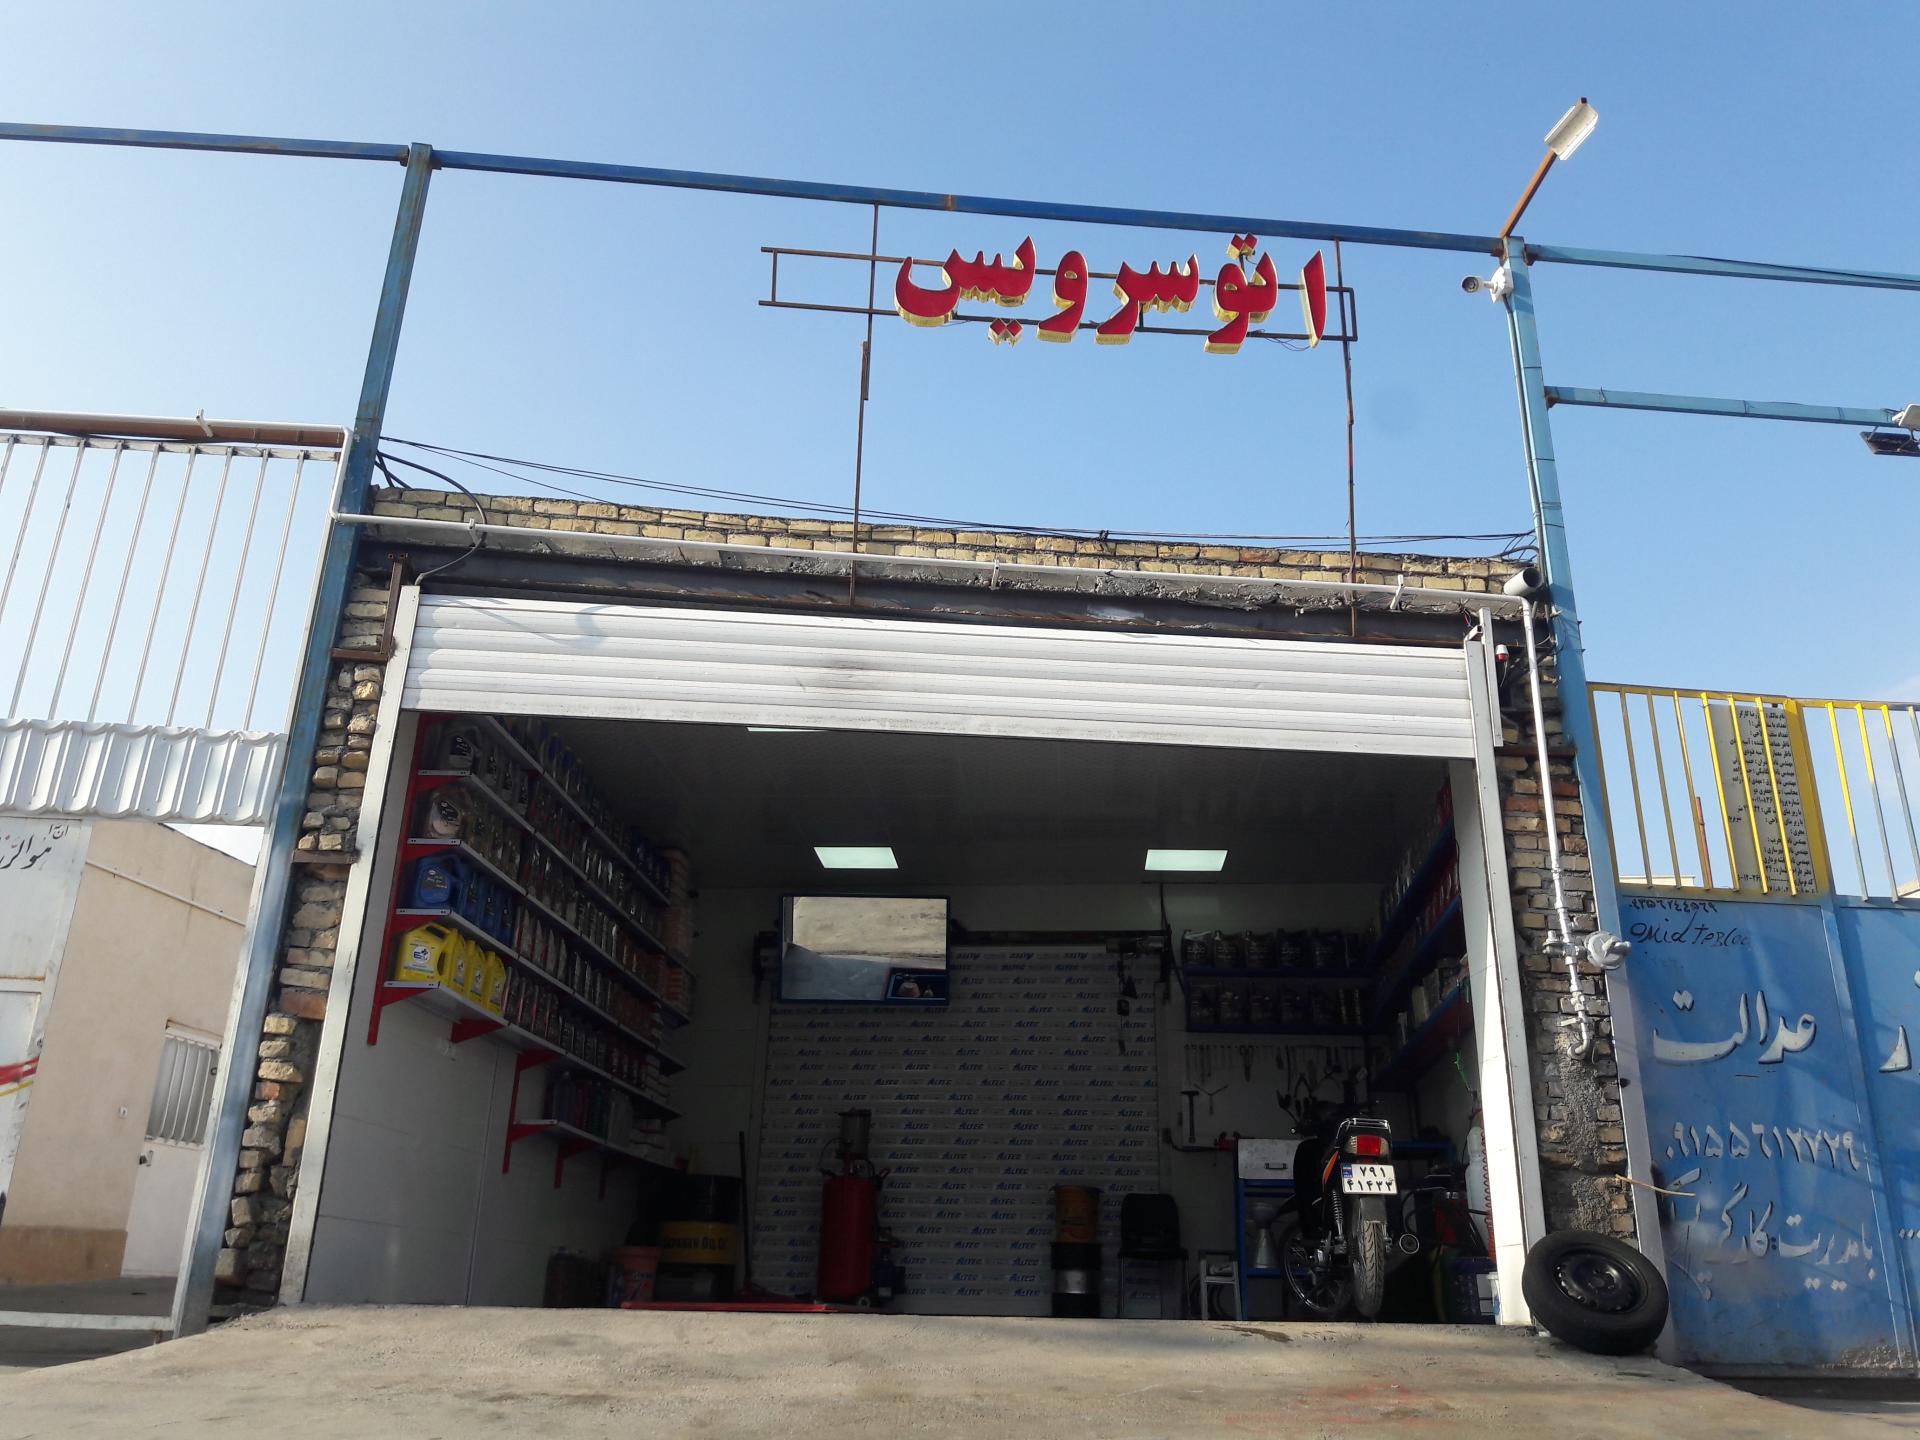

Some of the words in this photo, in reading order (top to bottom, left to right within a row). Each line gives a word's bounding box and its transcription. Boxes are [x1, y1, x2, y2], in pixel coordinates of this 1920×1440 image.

[1000, 963, 1025, 971] ALTEC
[1054, 963, 1078, 971] ALTEC
[1012, 976, 1036, 984] ALTEC
[1064, 976, 1089, 984] ALTEC
[970, 991, 994, 1000] ALTEC
[1022, 991, 1046, 999] ALTEC
[1075, 991, 1100, 999] ALTEC
[975, 1005, 1000, 1014] ALTEC
[1028, 1005, 1052, 1013] ALTEC
[1081, 1005, 1105, 1014] ALTEC
[805, 1020, 830, 1028] ALTEC
[857, 1020, 882, 1028] ALTEC
[909, 1020, 934, 1028] ALTEC
[961, 1020, 986, 1028] ALTEC
[1014, 1020, 1038, 1028] ALTEC
[1067, 1020, 1092, 1028] ALTEC
[1653, 990, 1817, 1065] عدالت
[816, 1035, 841, 1043] ALTEC
[868, 1034, 893, 1042] ALTEC
[920, 1034, 945, 1042] ALTEC
[974, 1034, 998, 1042] ALTEC
[1027, 1034, 1051, 1042] ALTEC
[1080, 1035, 1105, 1043] ALTEC
[796, 1048, 821, 1056] ALTEC
[849, 1048, 873, 1056] ALTEC
[902, 1048, 926, 1056] ALTEC
[955, 1048, 980, 1056] ALTEC
[1009, 1048, 1034, 1056] ALTEC
[1063, 1048, 1088, 1056] ALTEC
[799, 1062, 823, 1070] ALTEC
[851, 1062, 876, 1070] ALTEC
[904, 1062, 929, 1070] ALTEC
[958, 1063, 982, 1071] ALTEC
[1012, 1063, 1037, 1071] ALTEC
[1067, 1063, 1091, 1072] ALTEC
[1122, 1064, 1147, 1072] ALTEC
[768, 1078, 793, 1086] ALTEC
[821, 1078, 845, 1086] ALTEC
[874, 1077, 898, 1086] ALTEC
[926, 1077, 951, 1086] ALTEC
[980, 1078, 1004, 1086] ALTEC
[1034, 1078, 1058, 1086] ALTEC
[1088, 1079, 1112, 1087] ALTEC
[789, 1093, 813, 1101] ALTEC
[842, 1093, 866, 1101] ALTEC
[894, 1092, 919, 1100] ALTEC
[948, 1093, 972, 1101] ALTEC
[1002, 1093, 1026, 1101] ALTEC
[1056, 1093, 1080, 1102] ALTEC
[1111, 1094, 1135, 1102] ALTEC
[794, 1107, 818, 1115] ALTEC
[900, 1107, 924, 1115] ALTEC
[953, 1107, 978, 1115] ALTEC
[1008, 1107, 1032, 1116] ALTEC
[1062, 1108, 1086, 1116] ALTEC
[1117, 1109, 1142, 1117] ALTEC
[797, 1121, 821, 1129] ALTEC
[904, 1121, 928, 1130] ALTEC
[1013, 1122, 1038, 1130] ALTEC
[1068, 1123, 1092, 1131] ALTEC
[1124, 1124, 1148, 1132] ALTEC
[793, 1136, 818, 1144] ALTEC
[900, 1137, 924, 1145] ALTEC
[954, 1137, 978, 1145] ALTEC
[1008, 1138, 1032, 1146] ALTEC
[1063, 1138, 1087, 1146] ALTEC
[1118, 1139, 1142, 1147] ALTEC
[781, 1151, 806, 1159] ALTEC
[888, 1151, 912, 1159] ALTEC
[942, 1152, 966, 1160] ALTEC
[996, 1152, 1020, 1160] ALTEC
[1051, 1153, 1076, 1161] ALTEC
[1106, 1154, 1131, 1162] ALTEC
[786, 1164, 811, 1172] ALTEC
[894, 1165, 918, 1173] ALTEC
[948, 1166, 973, 1174] ALTEC
[1003, 1167, 1028, 1175] ALTEC
[1058, 1167, 1083, 1176] ALTEC
[1114, 1168, 1139, 1176] ALTEC
[1359, 1166, 1386, 1178] ۷۹۱
[777, 1179, 802, 1187] ALTEC
[941, 1182, 965, 1190] ALTEC
[996, 1182, 1020, 1190] ALTEC
[1108, 1183, 1132, 1191] ALTEC
[770, 1195, 794, 1203] ALTEC
[934, 1196, 958, 1204] ALTEC
[990, 1197, 1014, 1205] ALTEC
[772, 1208, 797, 1216] ALTEC
[935, 1210, 960, 1218] ALTEC
[990, 1211, 1015, 1220] ALTEC
[916, 1225, 940, 1234] ALTEC
[971, 1226, 996, 1234] ALTEC
[954, 1240, 978, 1248] ALTEC
[1010, 1241, 1035, 1249] ALTEC
[956, 1257, 980, 1265] ALTEC
[957, 1287, 981, 1295] ALTEC
